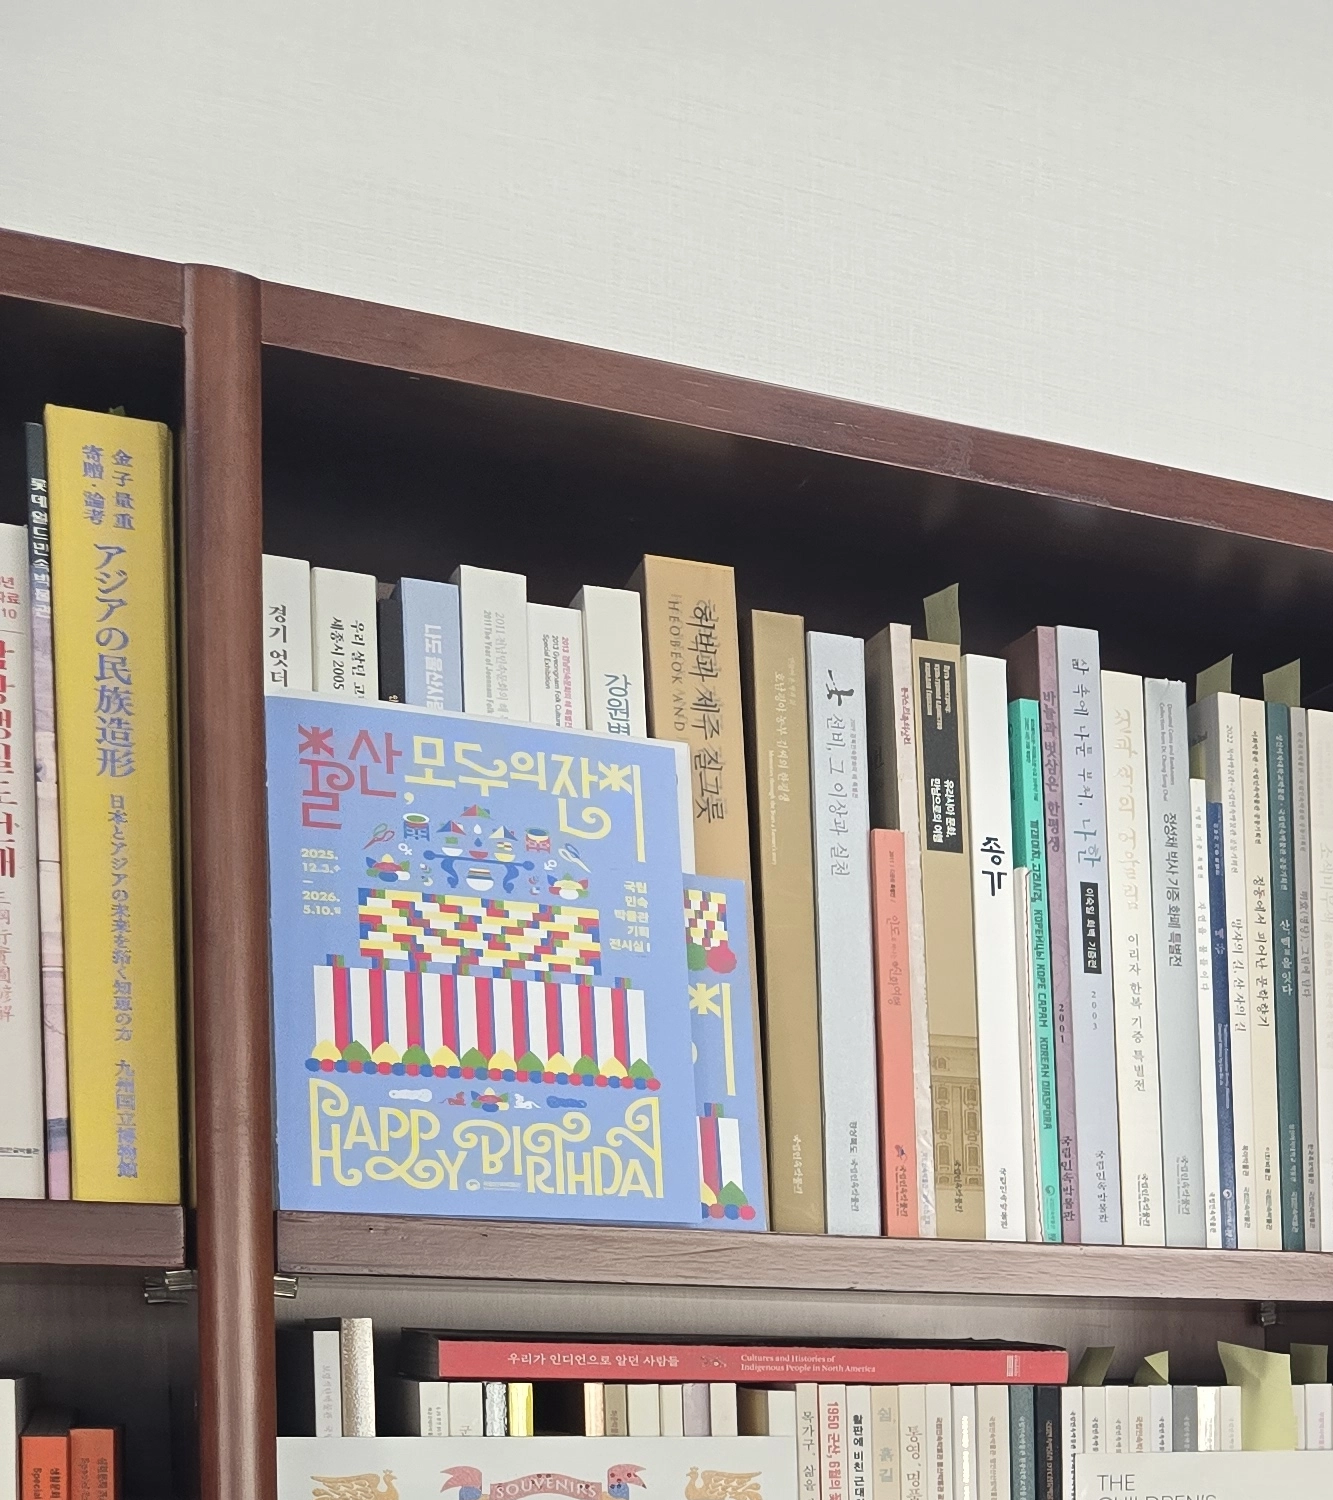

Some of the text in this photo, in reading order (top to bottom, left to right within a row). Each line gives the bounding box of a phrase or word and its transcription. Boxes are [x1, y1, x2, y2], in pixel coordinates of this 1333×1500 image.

[93, 542, 136, 778] アジアの民族造形
[329, 616, 345, 691] 세종시 2005
[542, 633, 552, 690] Special Exhibition
[690, 684, 722, 741] 제주
[1043, 690, 1058, 738] 바늘과
[826, 714, 850, 877] 선비, 그 이상과 실천
[944, 779, 956, 815] 유라시아
[301, 848, 339, 860] 2025.
[1047, 800, 1061, 853] 한평생
[302, 890, 341, 903] 2026.
[1163, 812, 1183, 967] 정성채 박사 기증 화폐 특별전
[1253, 874, 1271, 1028] 정동에서 피어난 문학향기
[1039, 1036, 1053, 1130] KOREAN DIASPORA
[507, 1353, 680, 1368] 우리가 인디언으로 알던 사람들
[32, 1467, 43, 1500] Special
[1096, 1473, 1136, 1492] THE
